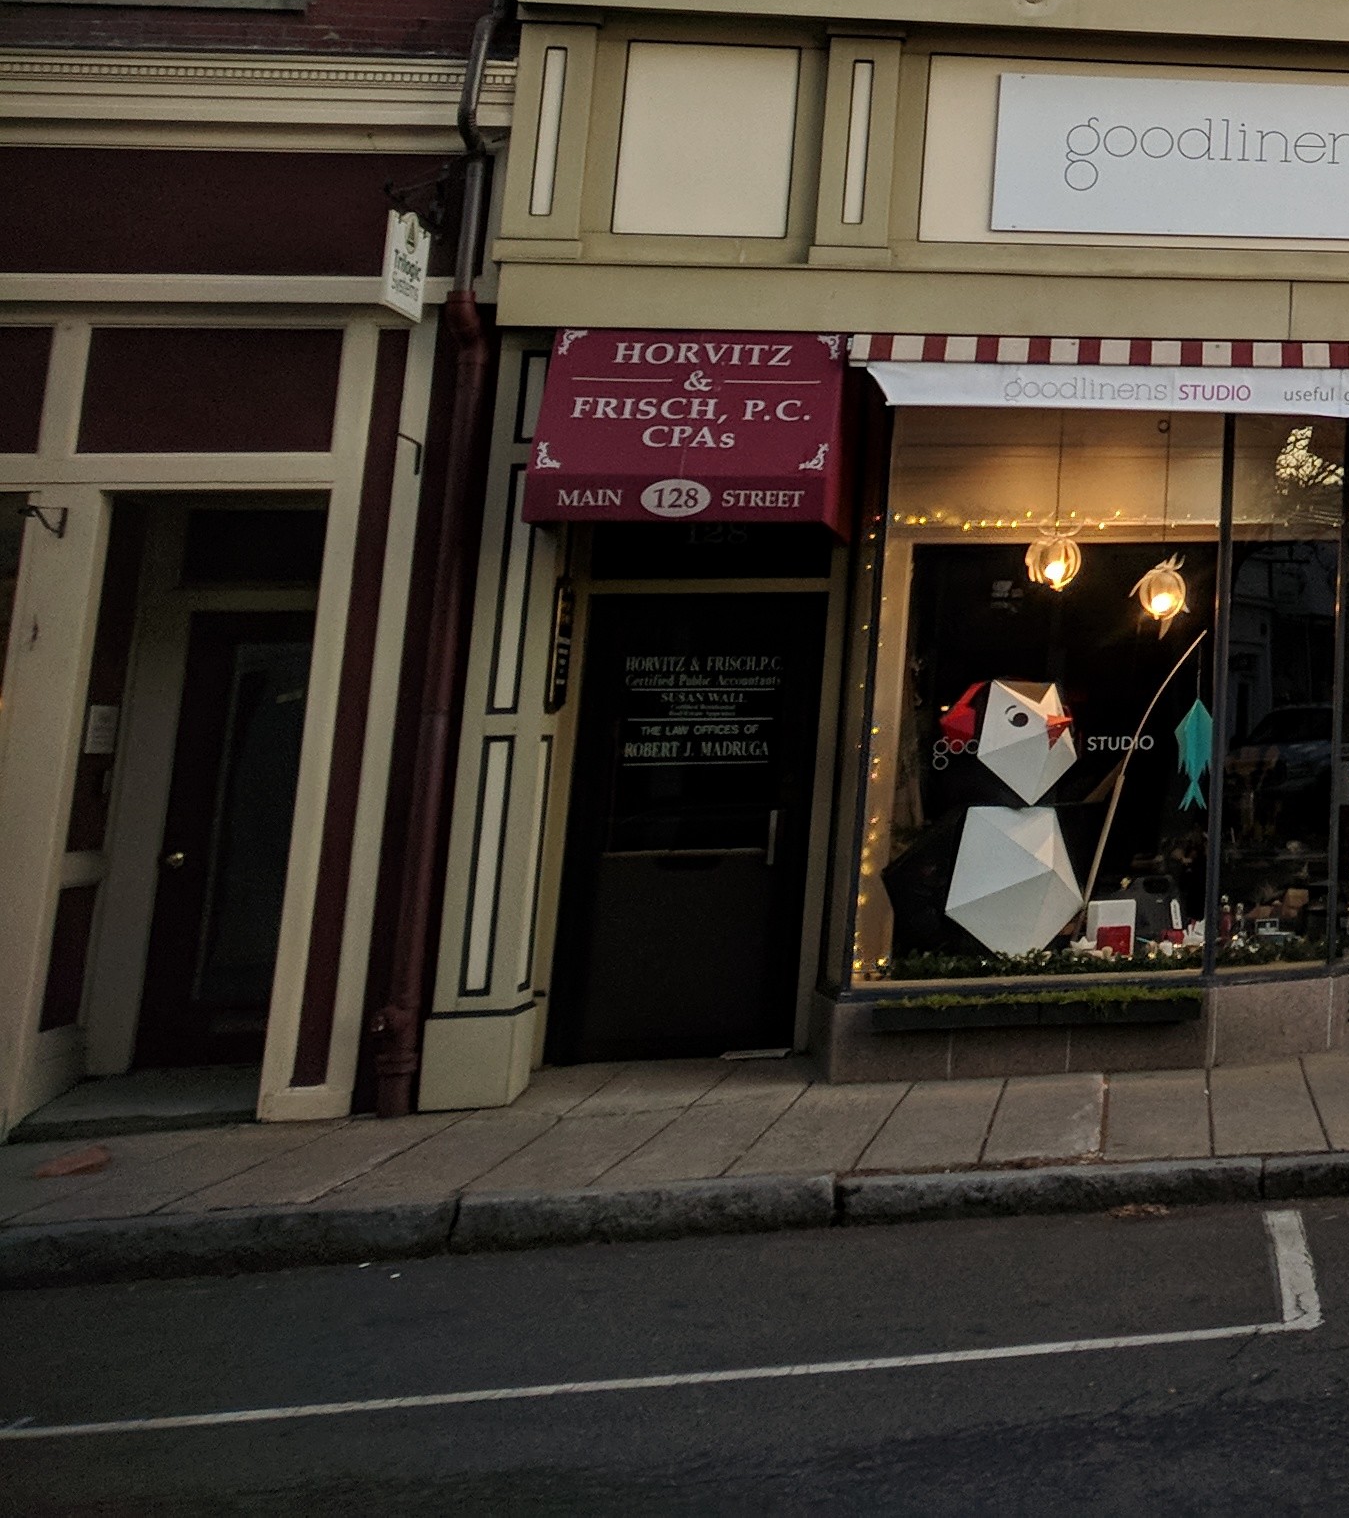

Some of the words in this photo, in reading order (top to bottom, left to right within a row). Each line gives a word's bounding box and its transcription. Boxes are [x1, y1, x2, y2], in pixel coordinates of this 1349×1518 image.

[613, 342, 793, 366] HORVITZ
[683, 369, 713, 391] &
[1003, 376, 1168, 403] goodlinens
[1178, 383, 1252, 401] STUDIO
[1283, 386, 1335, 403] useful
[570, 396, 728, 424] FRISCH,
[742, 398, 812, 421] P.C.
[641, 425, 736, 449] CPAs
[557, 488, 623, 507] MAIN
[653, 487, 699, 509] 128
[721, 490, 805, 508] STREET
[625, 655, 687, 672] HORVITZ
[689, 656, 701, 672] &
[660, 692, 705, 703] SUSAN
[640, 725, 663, 736] THE
[665, 724, 690, 736] LAW
[693, 724, 740, 735] OFFICES
[743, 724, 760, 735] OF
[623, 741, 681, 758] ROBERT
[700, 740, 770, 757] MADRUGA
[1086, 734, 1155, 752] STUDIO
